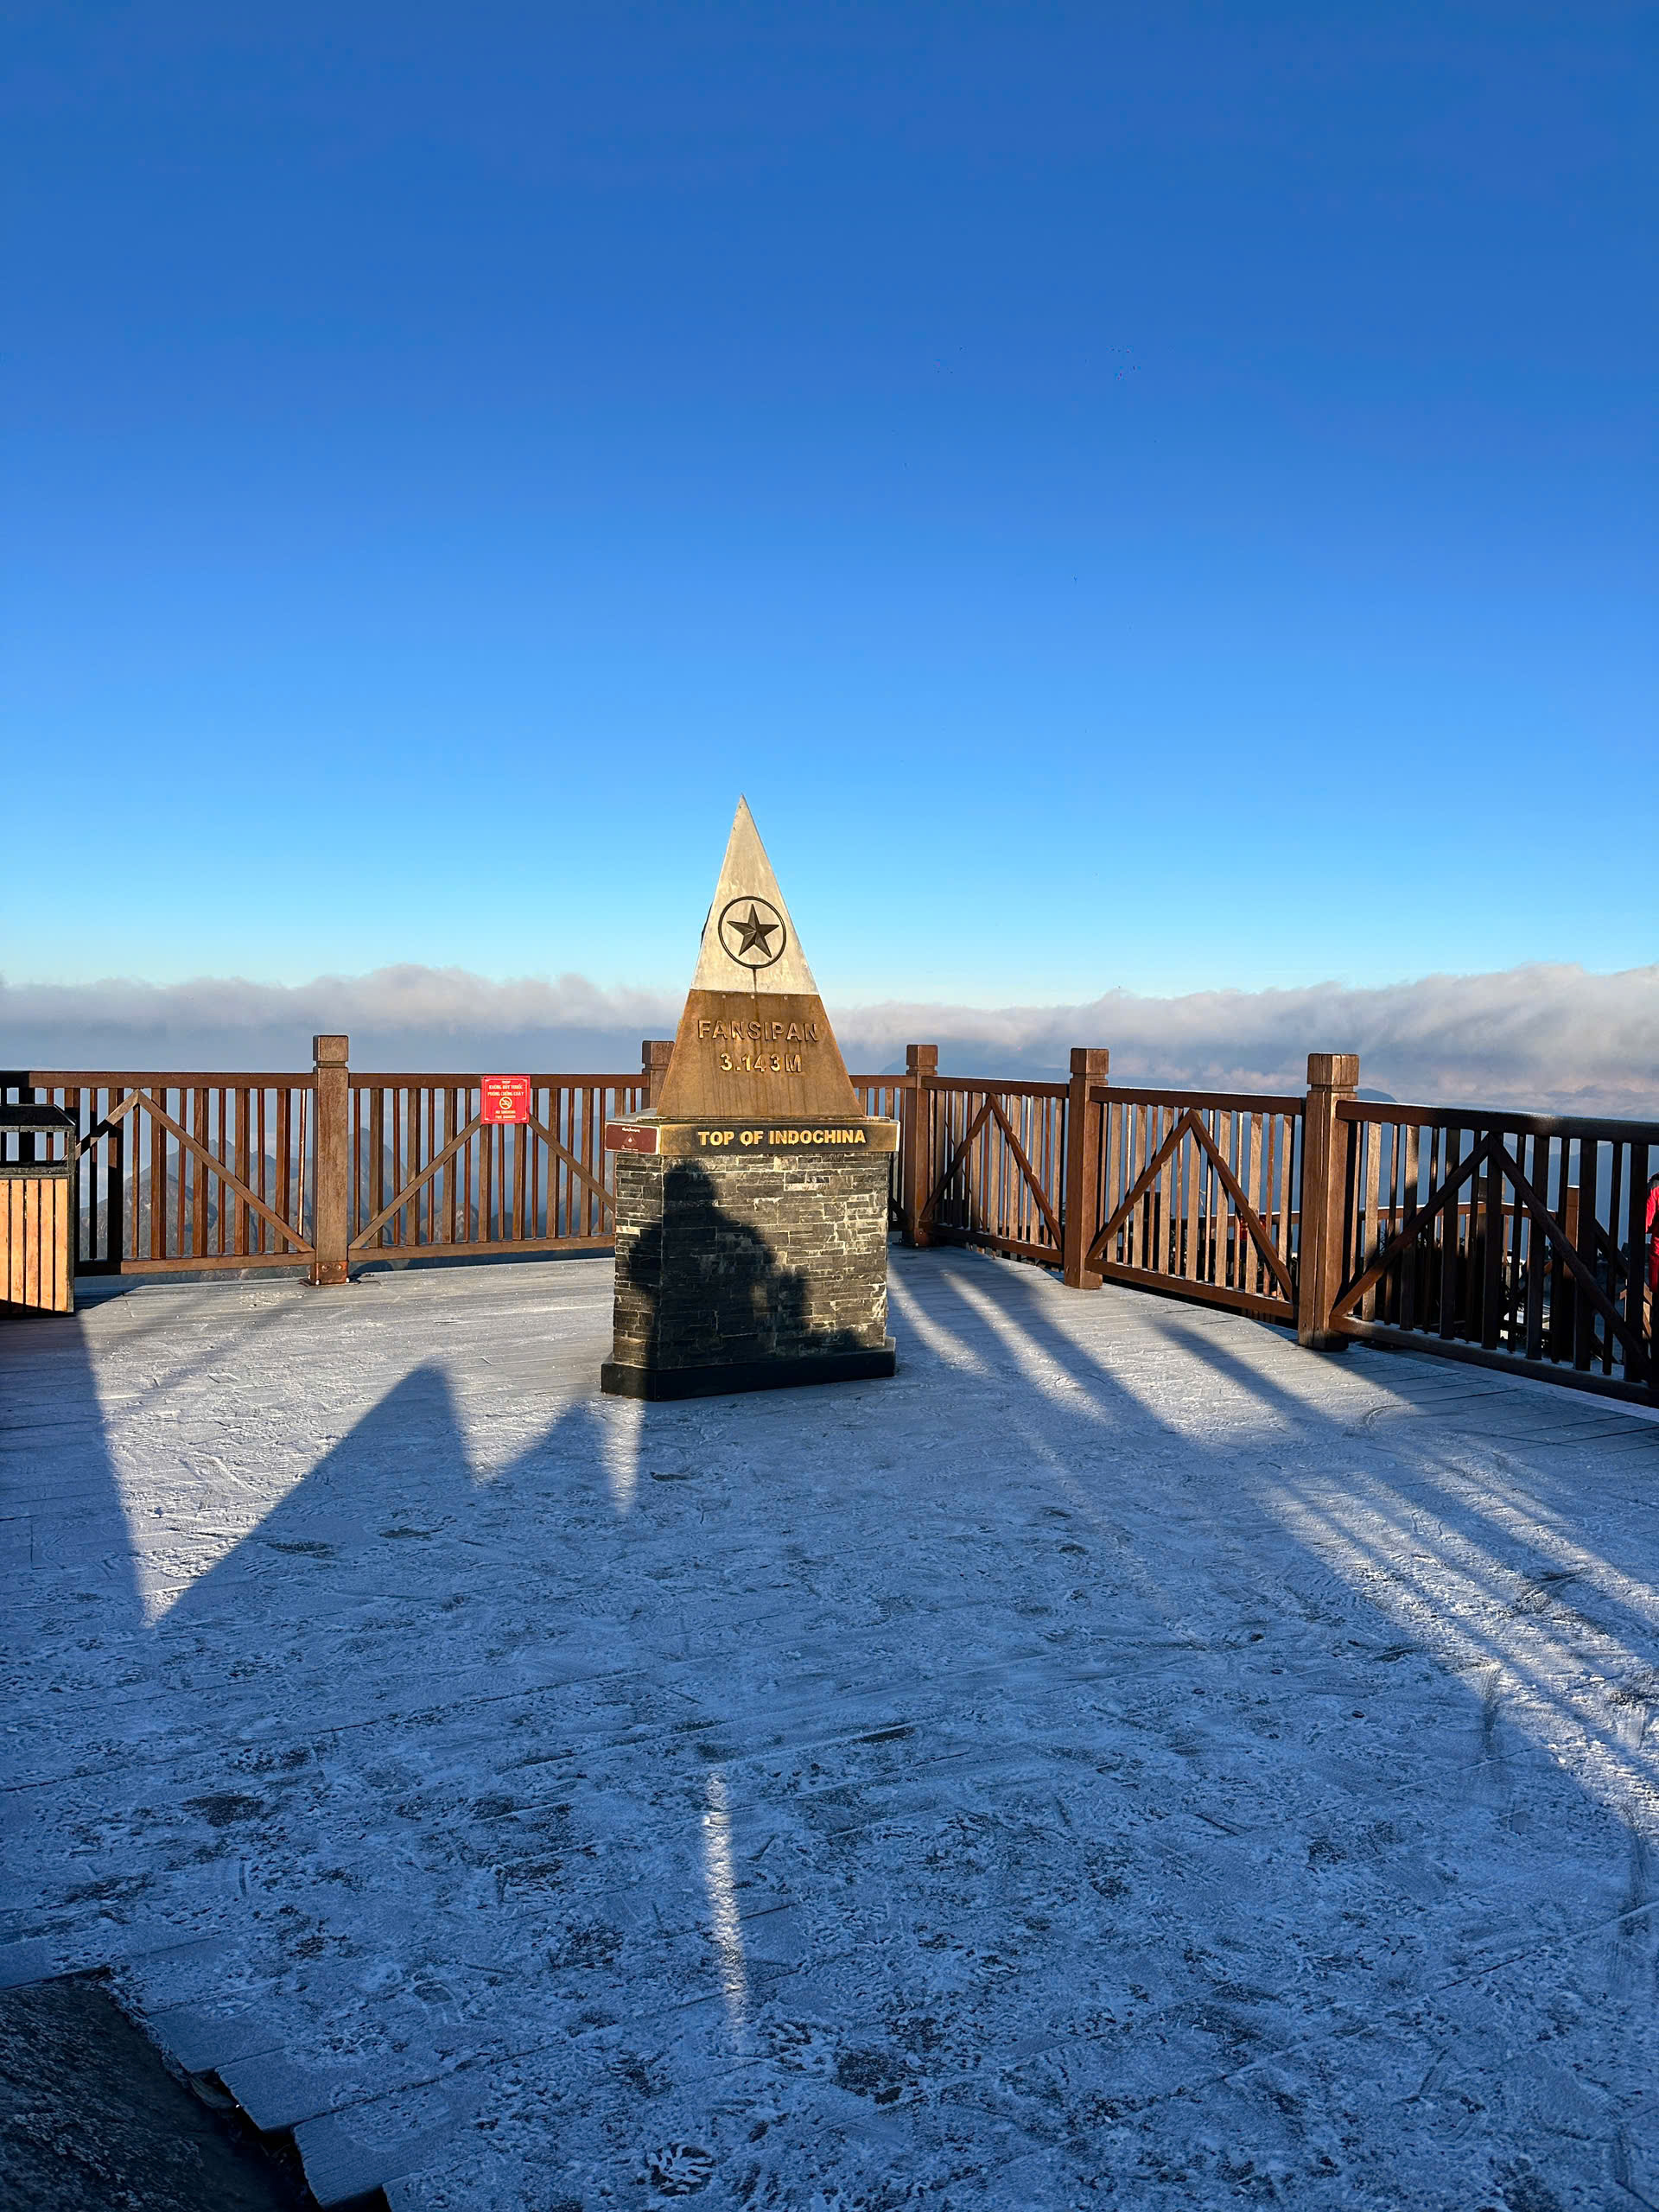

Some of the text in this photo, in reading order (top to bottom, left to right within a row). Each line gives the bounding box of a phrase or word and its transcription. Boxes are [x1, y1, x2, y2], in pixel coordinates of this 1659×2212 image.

[698, 1020, 819, 1042] FANSIPAN
[697, 1129, 867, 1146] TOP OF INDOCHINA
